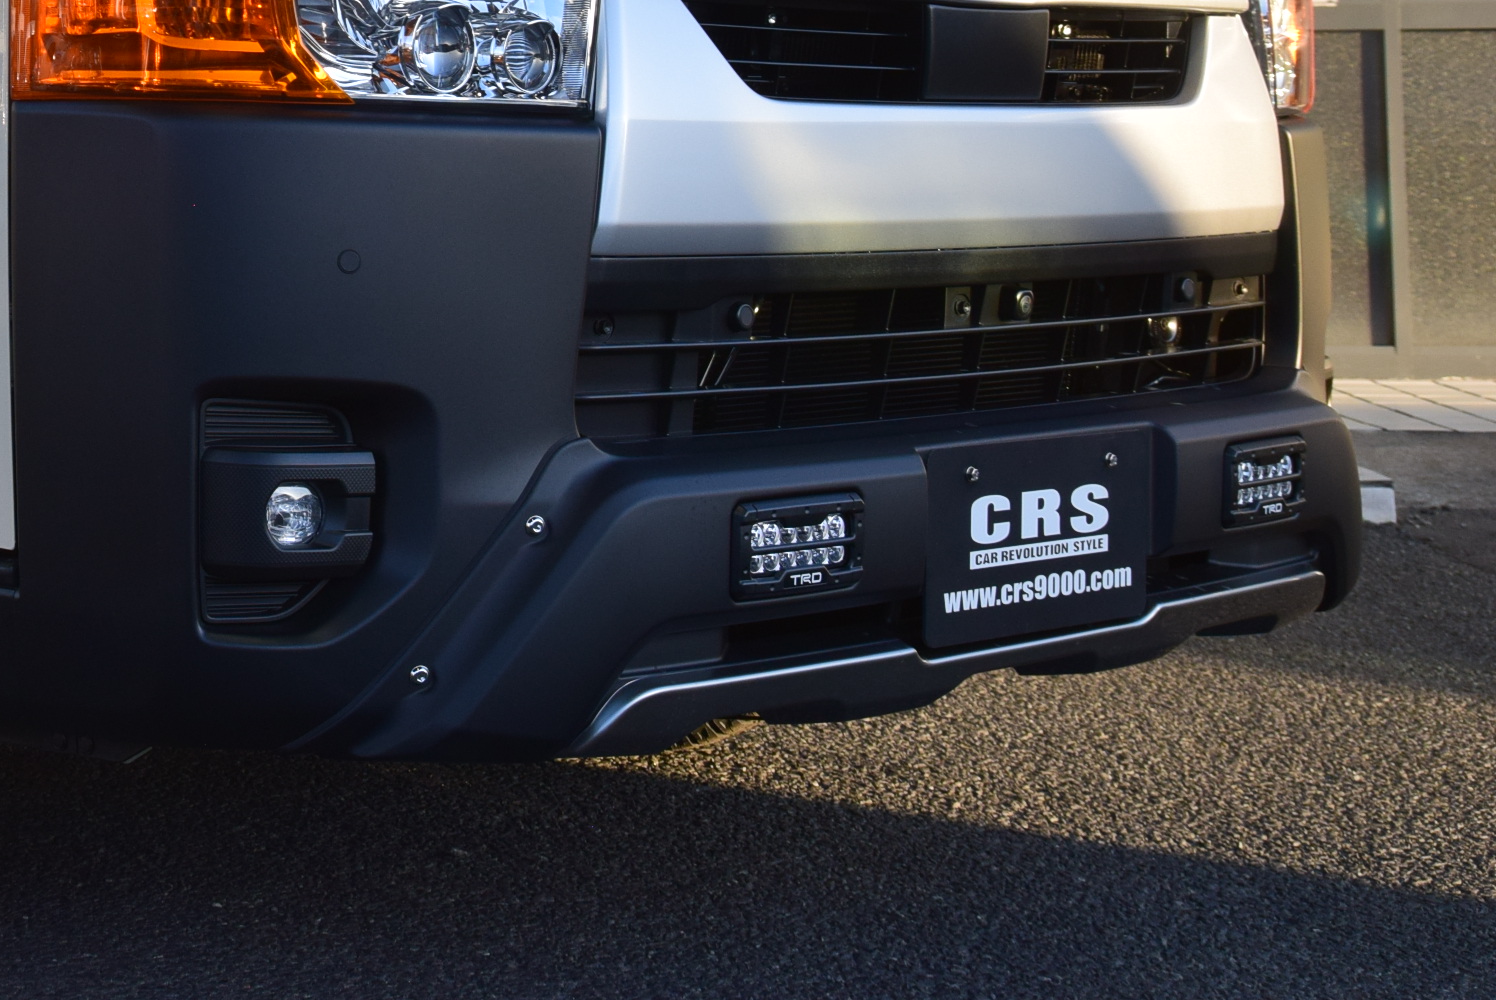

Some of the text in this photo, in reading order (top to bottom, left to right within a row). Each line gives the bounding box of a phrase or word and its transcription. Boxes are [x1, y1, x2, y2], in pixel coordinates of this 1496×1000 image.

[970, 484, 1109, 544] CRS
[1262, 503, 1283, 515] TRD
[975, 538, 1104, 566] CAR REVOLUTION STYLE
[790, 571, 822, 586] TRD
[944, 566, 1132, 614] www.crs9000.com
